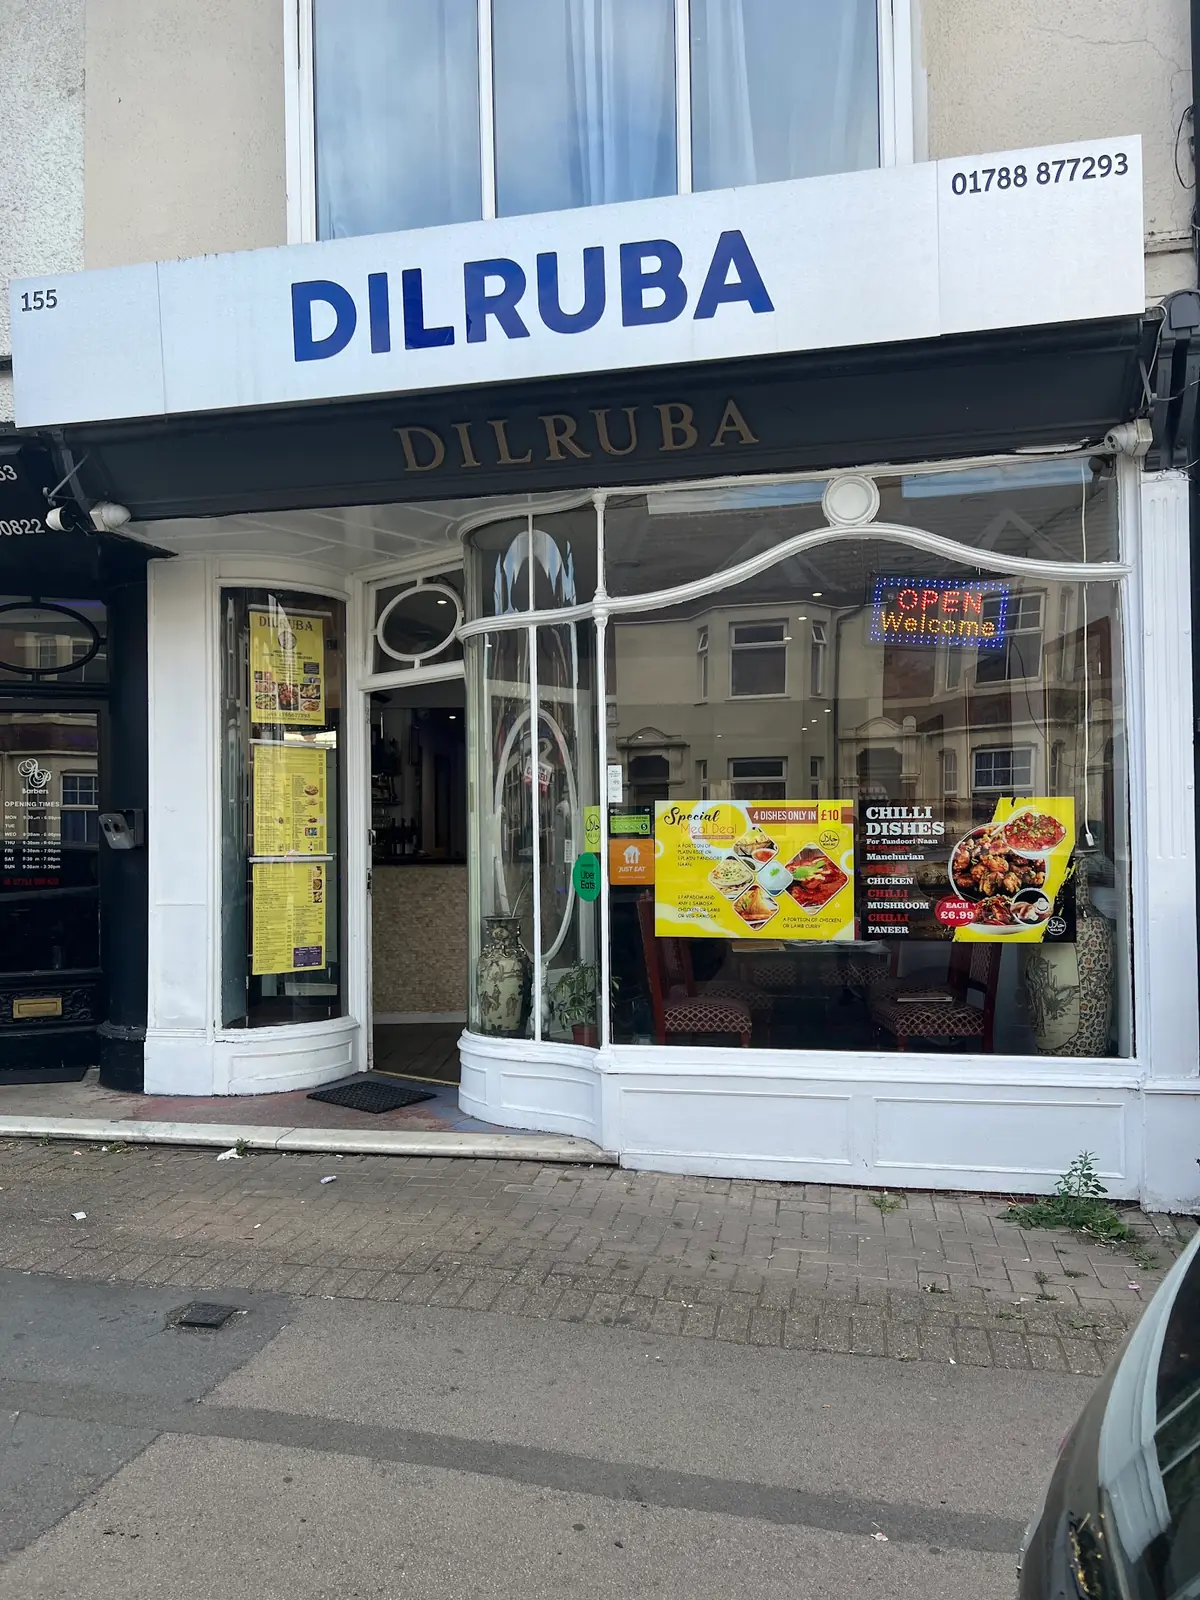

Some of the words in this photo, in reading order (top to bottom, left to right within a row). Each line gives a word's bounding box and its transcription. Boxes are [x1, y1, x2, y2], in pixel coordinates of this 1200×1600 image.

[951, 164, 1028, 196] 01788
[1036, 152, 1129, 185] 877293
[21, 289, 58, 312] 155
[291, 230, 776, 363] DILRUBA
[393, 399, 760, 472] DILRUBA
[0, 518, 46, 536] 0822
[898, 588, 983, 614] OPEN
[881, 611, 995, 637] Welcome
[22, 787, 49, 795] Barbers
[664, 806, 720, 825] Special
[753, 811, 759, 820] 4
[760, 811, 787, 820] DISHES
[788, 811, 807, 820] ONLY
[808, 810, 816, 820] IN
[821, 809, 839, 820] £10
[866, 806, 933, 819] CHILLI
[680, 823, 708, 834] Meal
[712, 823, 737, 834] Deal
[866, 822, 945, 835] DISHES
[580, 871, 595, 880] Uber
[580, 880, 596, 889] Eats
[867, 889, 909, 898] CHILLI
[867, 901, 930, 909] MUSHROOM
[867, 913, 909, 922] CHILLI
[940, 911, 975, 919] £6.99
[867, 926, 909, 934] PANEER
